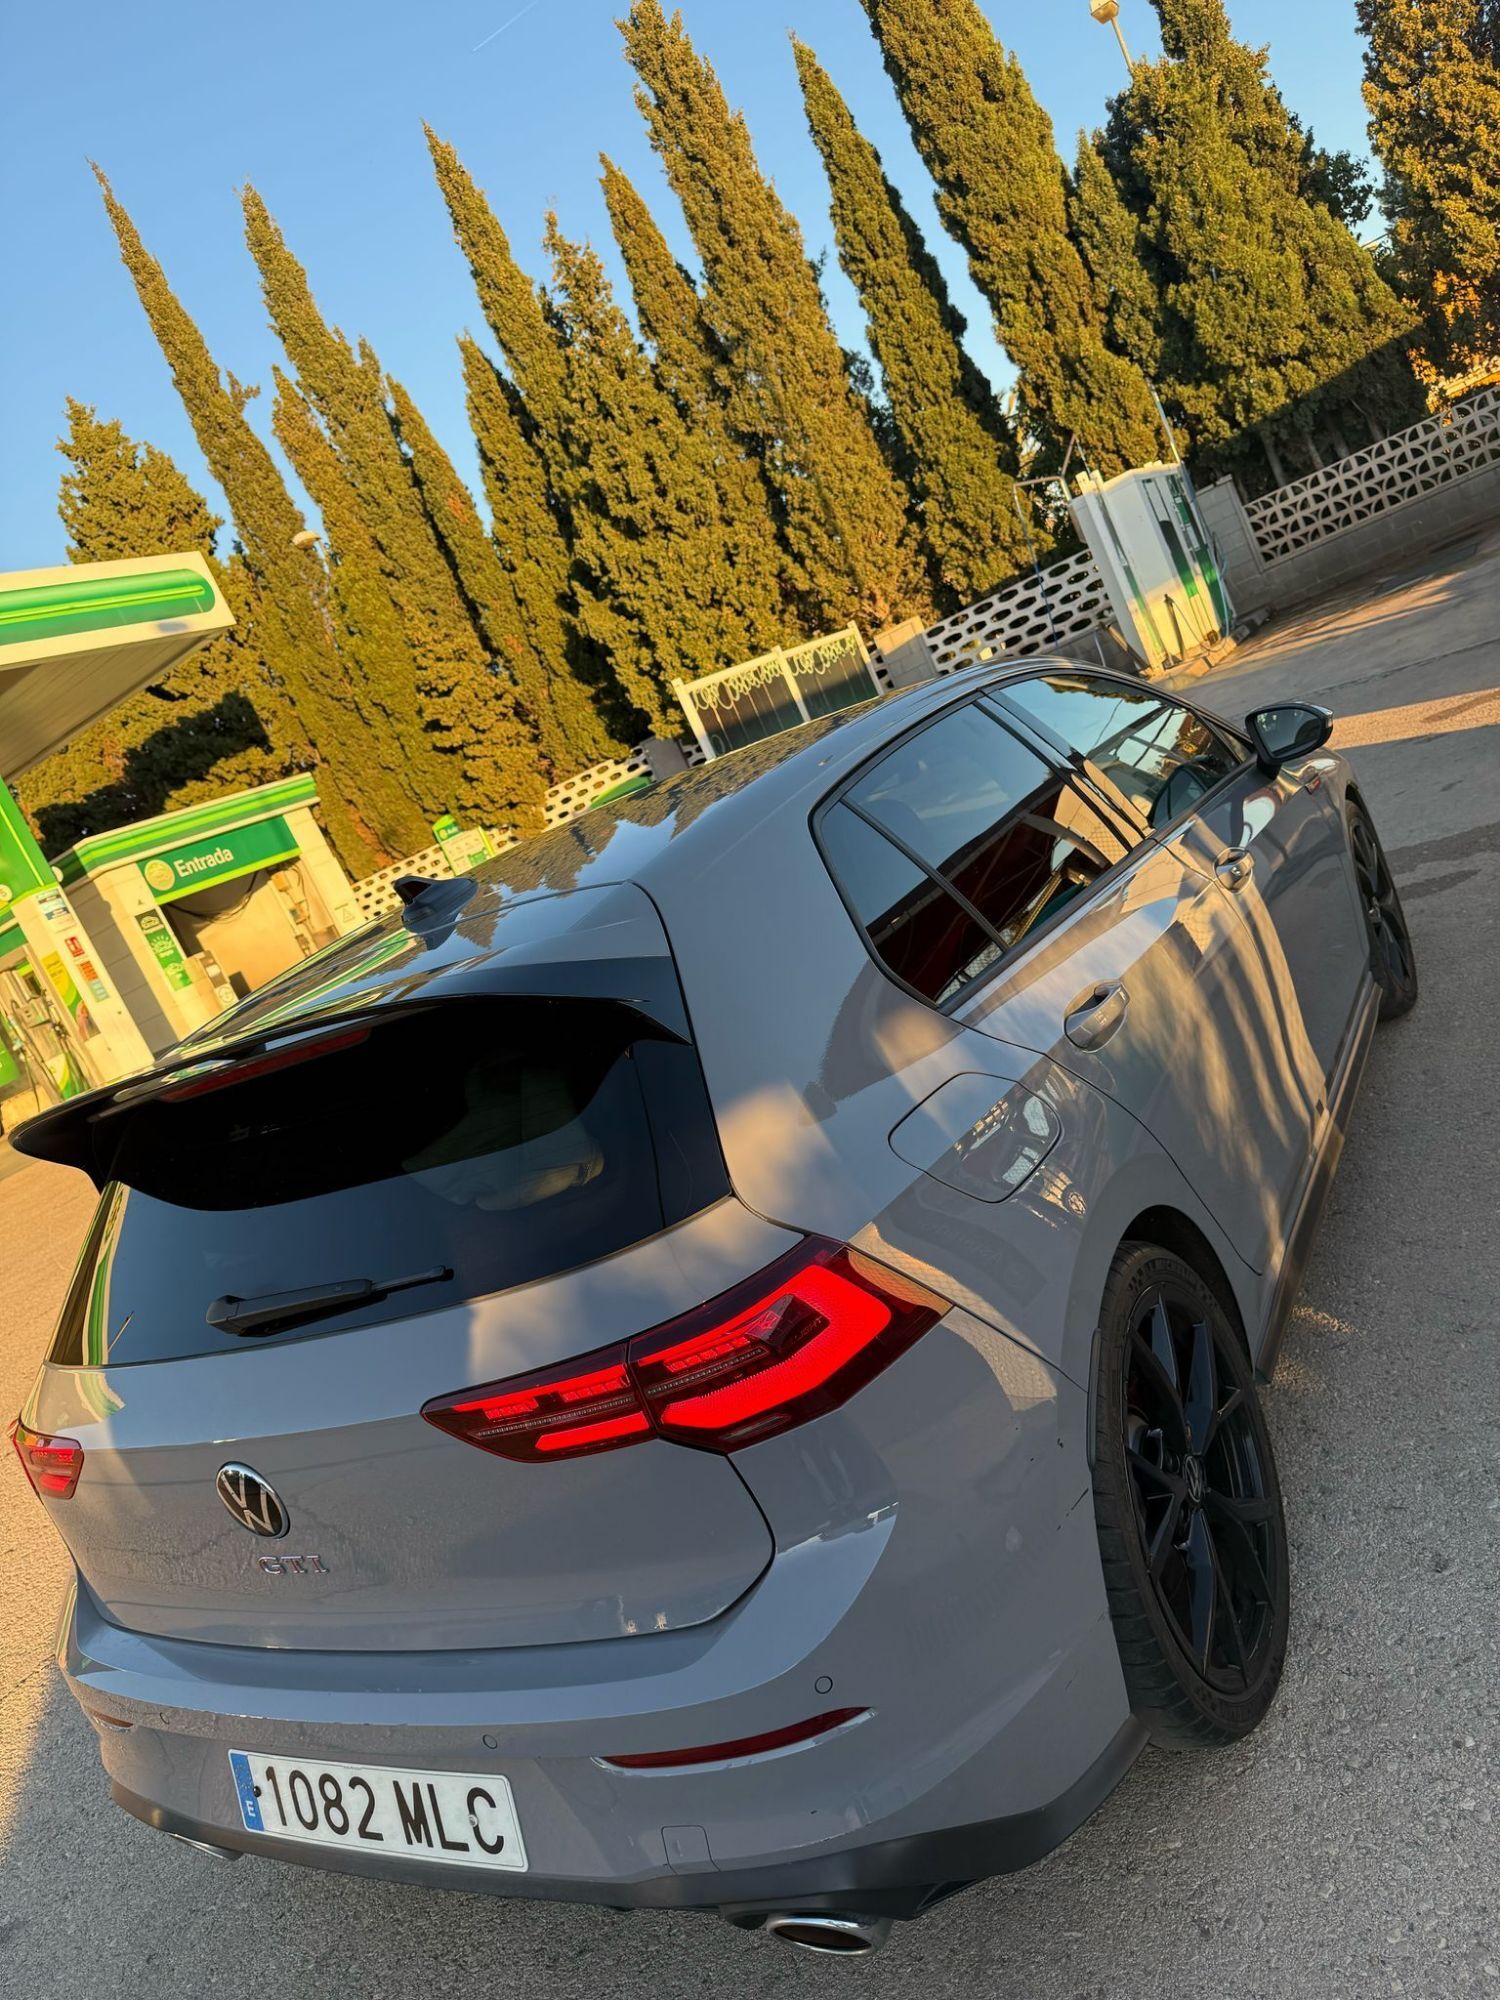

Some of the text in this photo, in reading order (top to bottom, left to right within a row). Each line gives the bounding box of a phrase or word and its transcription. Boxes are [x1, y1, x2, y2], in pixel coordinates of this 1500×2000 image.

[174, 848, 234, 877] Entrada
[257, 1554, 329, 1575] GTI
[245, 1800, 257, 1818] E
[265, 1766, 504, 1855] 1082 MLC
